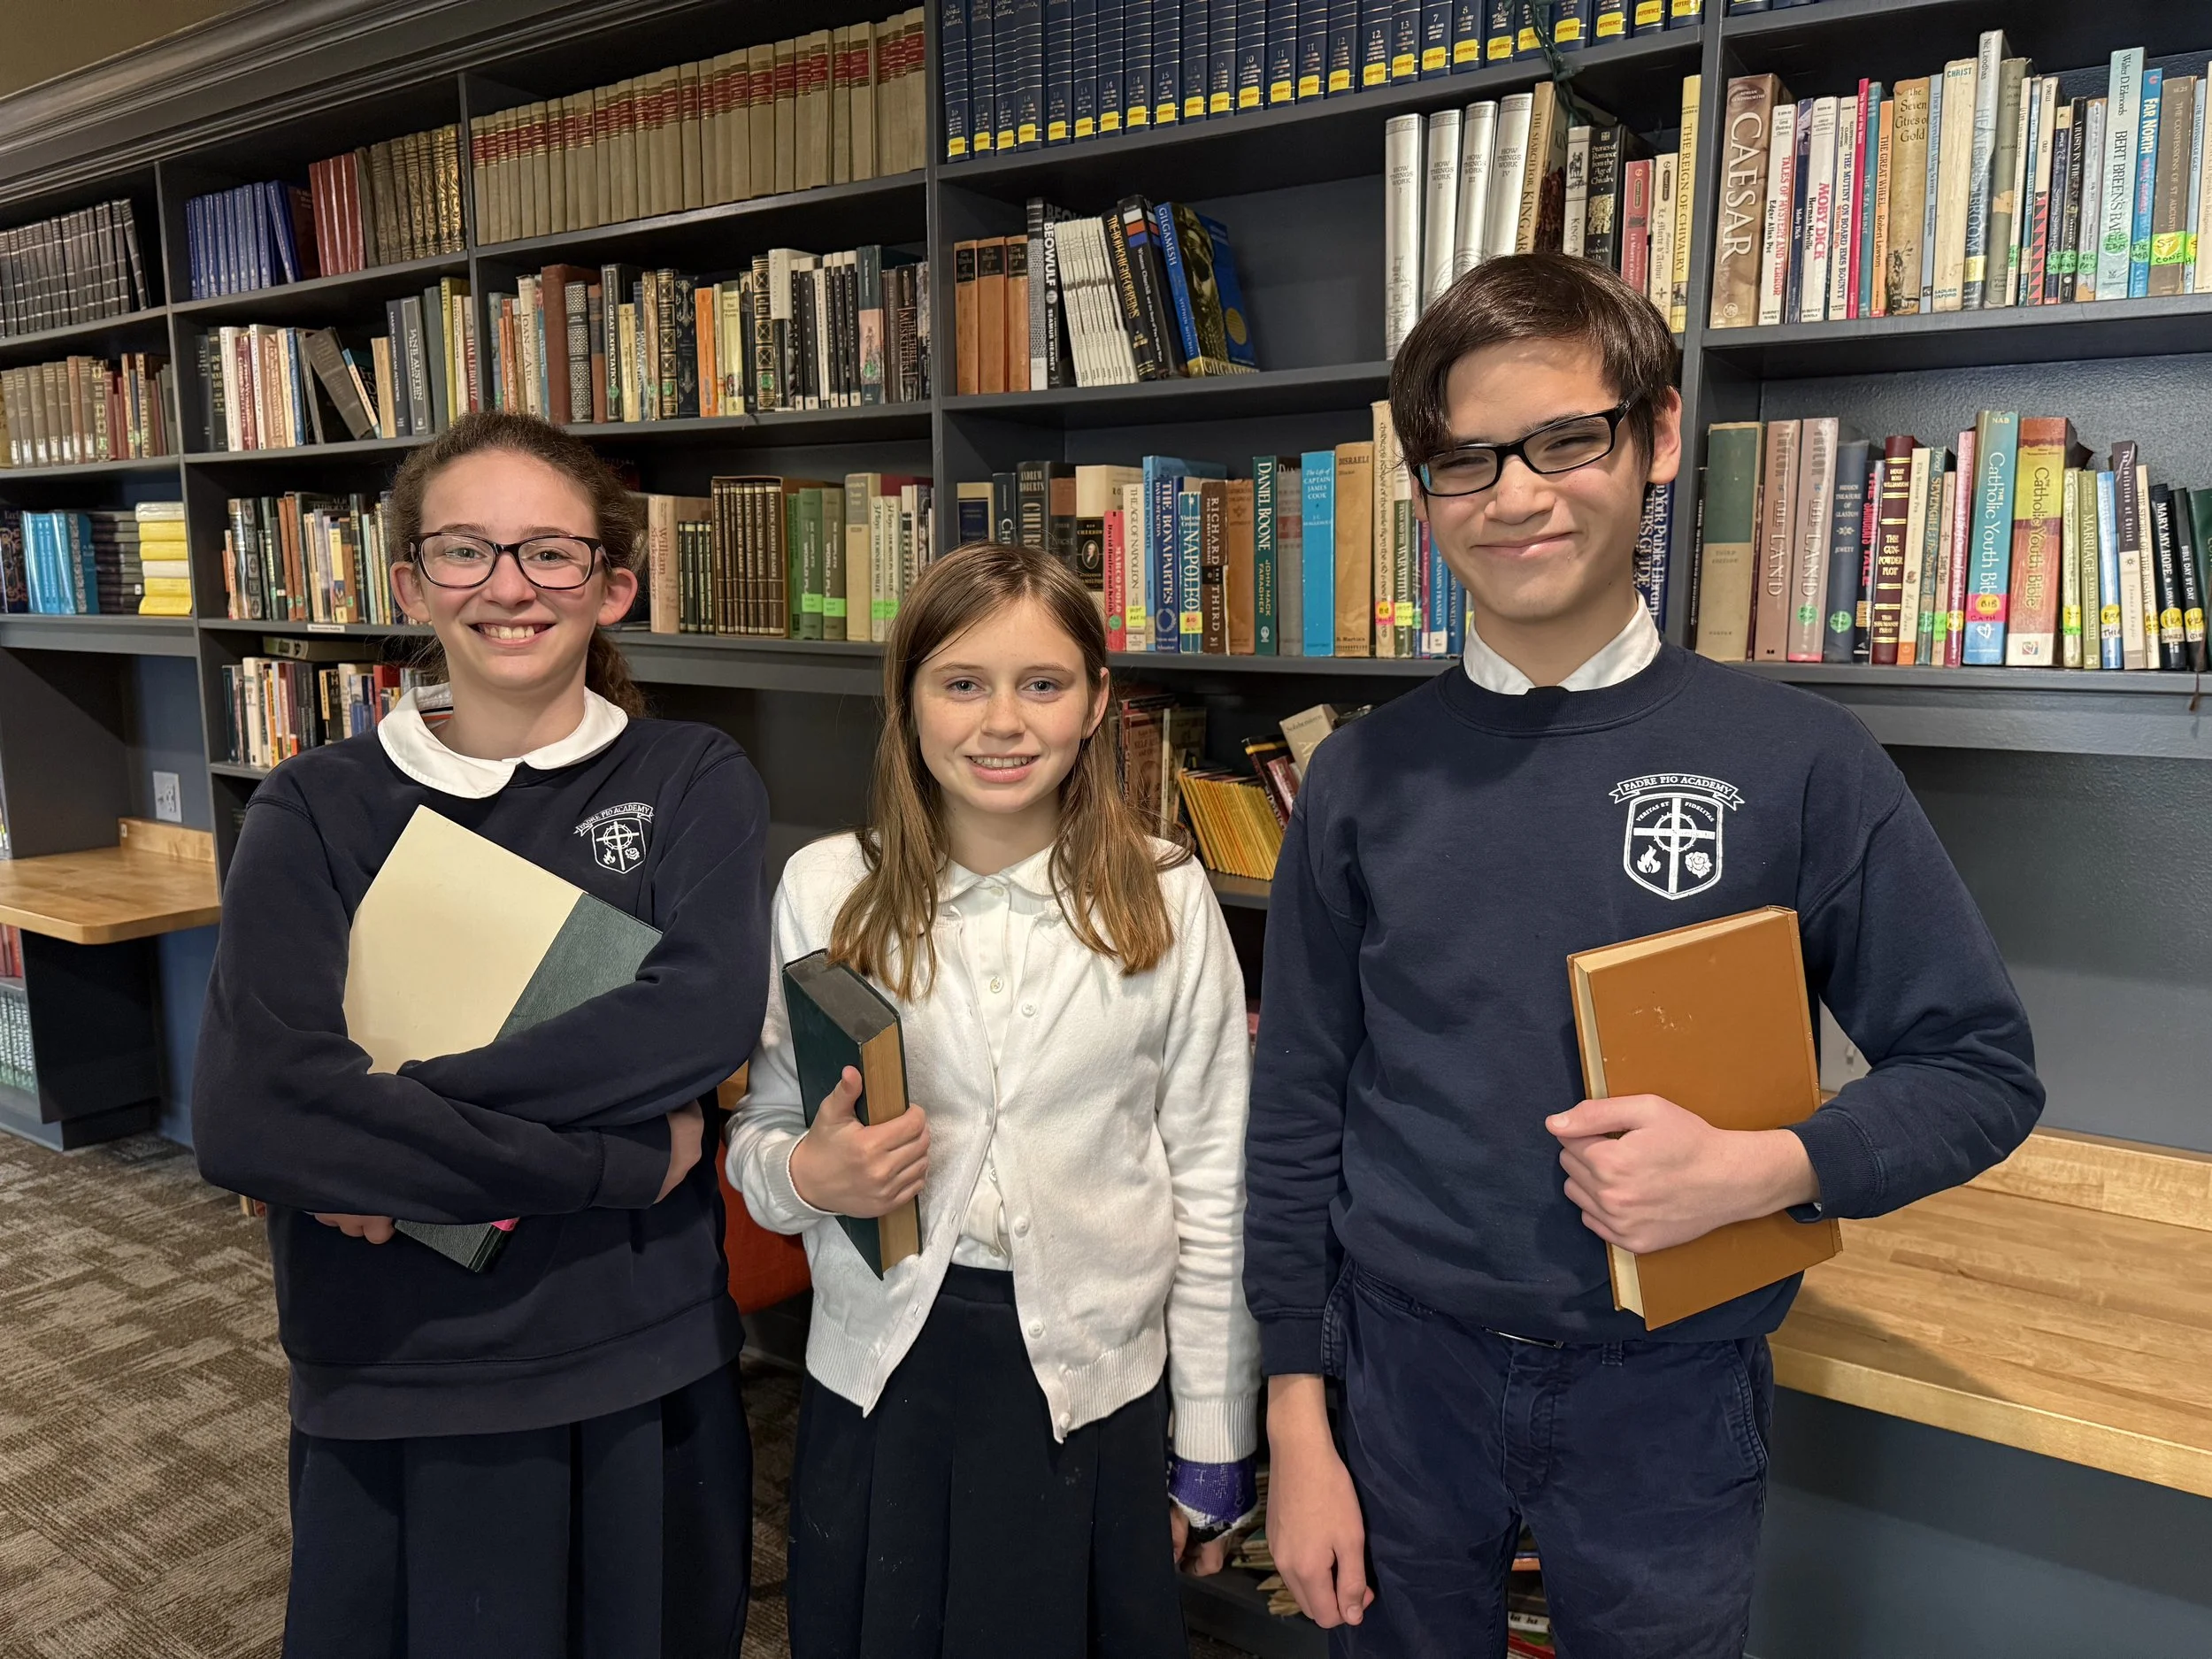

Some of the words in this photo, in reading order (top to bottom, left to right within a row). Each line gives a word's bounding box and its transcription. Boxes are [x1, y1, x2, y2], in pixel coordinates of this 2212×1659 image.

[1432, 13, 1439, 23] 7
[1947, 67, 1972, 79] CHRIST
[1981, 50, 1990, 80] Leodhas
[2121, 54, 2131, 74] Walter
[1901, 99, 1927, 111] Seven
[2117, 85, 2128, 115] Edmonds
[2144, 98, 2159, 118] FAR
[1683, 124, 1692, 150] THE
[1901, 128, 1924, 142] Gold
[2115, 131, 2127, 159] BERT
[2141, 119, 2157, 154] NORTH
[2172, 120, 2181, 170] CONFESSIONS
[1529, 133, 1539, 165] SEARCH
[1843, 152, 1852, 169] THE
[1390, 172, 1413, 180] THINGS
[1680, 152, 1690, 190] REIGN
[1781, 156, 1790, 183] TALES
[1879, 152, 1888, 178] GREAT
[2171, 173, 2178, 182] OF
[1721, 112, 1763, 264] CAESAR
[1780, 187, 1788, 197] OF
[1842, 171, 1851, 201] MUTINY
[1878, 180, 1887, 207] WHEEL
[2110, 164, 2125, 210] BREEN'S
[1519, 191, 1534, 228] KING
[1679, 195, 1688, 210] OF
[1807, 197, 1816, 223] Herman
[1816, 183, 1830, 222] MOBY
[1841, 204, 1849, 216] ON
[1766, 222, 1775, 240] Allan
[1777, 200, 1788, 238] MYSTERY
[1839, 218, 1848, 245] BOARD
[1876, 215, 1885, 238] Robert
[1967, 197, 1980, 251] BROOM
[1158, 208, 1177, 265] GILGAMESH
[1676, 213, 1687, 273] CHIVALRY
[1775, 241, 1785, 258] AND
[1805, 225, 1814, 250] Melville
[1814, 227, 1827, 260] DICK
[1044, 222, 1056, 286] BEOWULF
[1839, 248, 1847, 265] HMS
[1875, 241, 1884, 267] Lawson
[2156, 253, 2182, 264] CONF
[1142, 271, 1151, 294] Churchill
[1773, 260, 1784, 296] TERROR
[1837, 268, 1847, 299] BOUNTY
[1179, 298, 1188, 323] STEPHEN
[410, 329, 419, 357] JANE
[899, 311, 910, 371] MUSKETEERS
[413, 359, 423, 400] AUSTEN
[1339, 456, 1369, 465] DISRAELI
[1933, 450, 1943, 471] Reed
[1019, 481, 1044, 492] ROBERTS
[1021, 471, 1041, 480] ANDREW
[1257, 463, 1271, 507] DANIEL
[1985, 452, 2004, 518] Catholic
[2123, 467, 2131, 503] Imitation
[1163, 481, 1171, 510] THE
[1654, 495, 1668, 522] York
[2032, 467, 2049, 525] Catholic
[1258, 509, 1271, 550] BOONE
[2125, 518, 2134, 542] Christ
[2156, 503, 2168, 531] MARY
[1131, 525, 1139, 537] OF
[1886, 534, 1899, 543] THE
[1981, 521, 2000, 568] Youth
[2083, 514, 2094, 573] MARRIAGE
[2159, 534, 2170, 548] MY
[659, 527, 669, 574] William
[1397, 545, 1407, 566] WAR
[1653, 526, 1667, 565] Public
[2027, 528, 2045, 569] Youth
[2181, 546, 2191, 561] BIBLE
[1163, 515, 1172, 604] BONAPARTES
[1767, 534, 1786, 596] LAND
[1801, 534, 1821, 596] LAND
[1862, 551, 1872, 587] TALE
[1878, 557, 1903, 565] POWDER
[1882, 567, 1898, 576] PLOT
[2160, 549, 2171, 576] HOPE
[2183, 563, 2192, 576] DAY
[1397, 568, 1407, 592] WITH
[1648, 566, 1664, 616] Library
[2025, 575, 2042, 608] Bible
[2185, 587, 2194, 600] DAY
[1623, 776, 1657, 791] PADRE
[1680, 776, 1732, 795] ACADEMY
[580, 816, 601, 829] PADRE
[614, 805, 649, 814] ACADEMY
[1636, 804, 1660, 822] VERITAS
[1685, 802, 1715, 822] FIDELITAS
